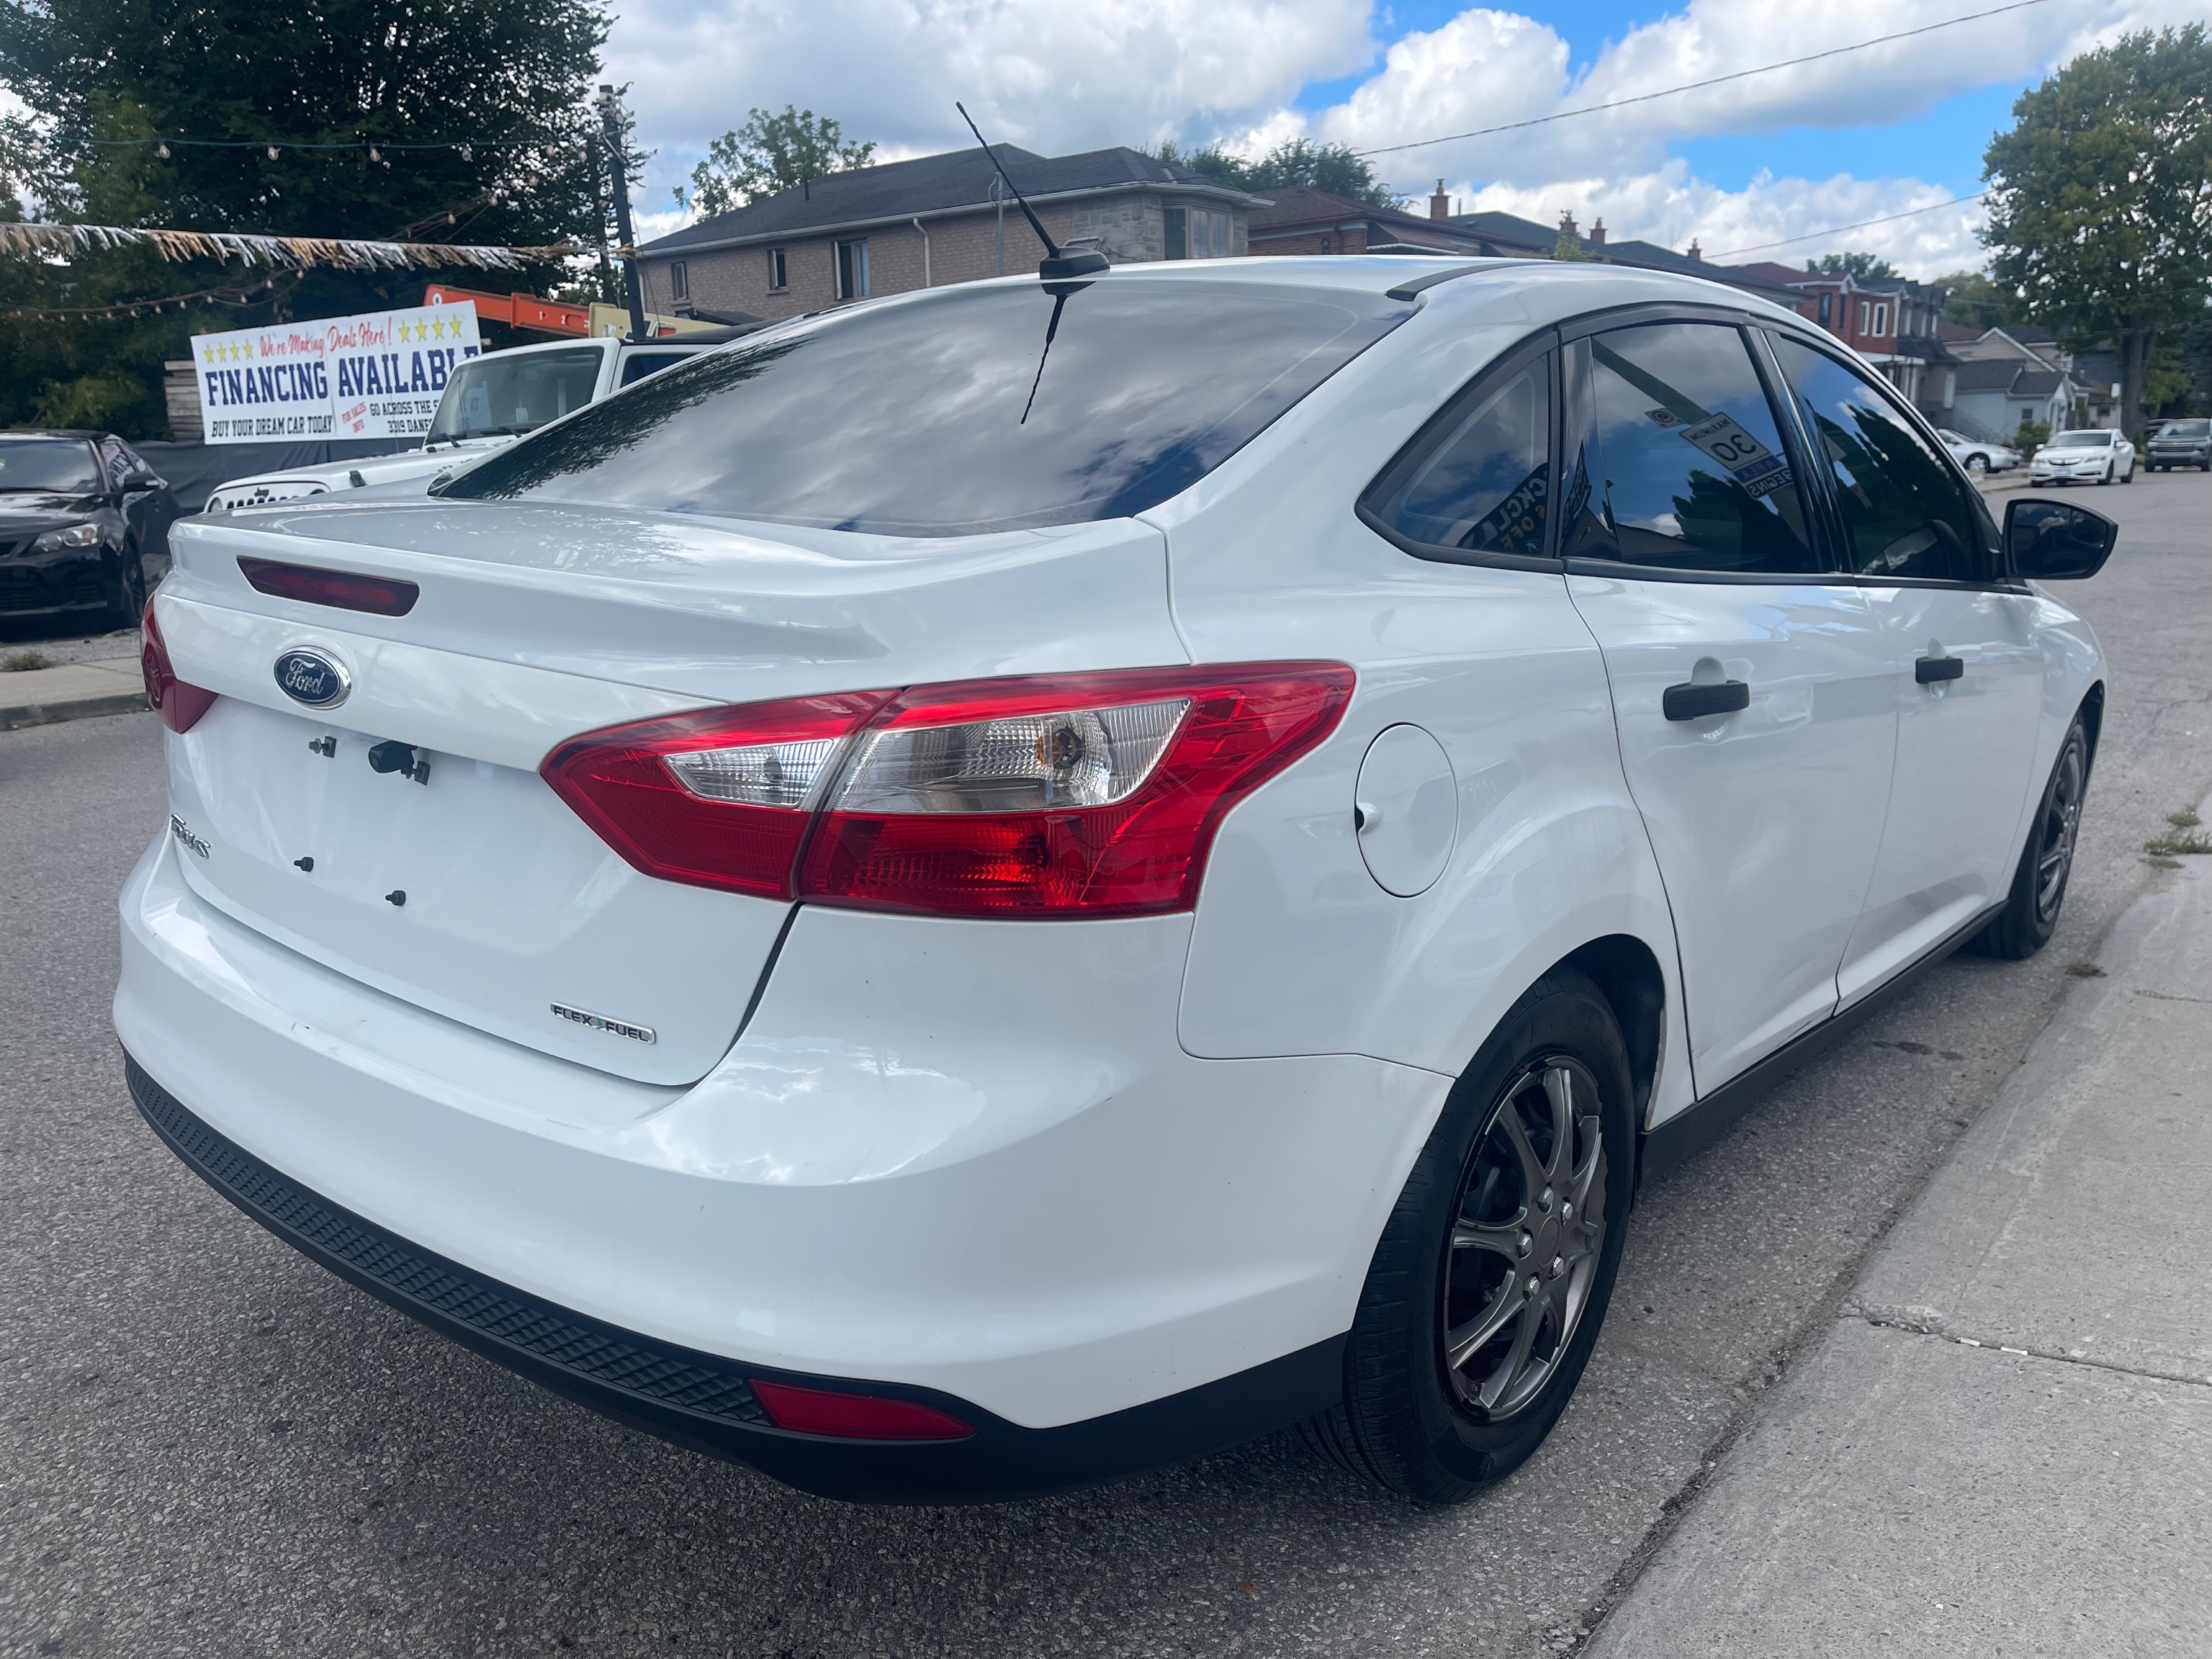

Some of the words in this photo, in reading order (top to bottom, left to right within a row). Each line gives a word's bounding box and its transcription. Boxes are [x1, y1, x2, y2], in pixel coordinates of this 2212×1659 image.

[259, 331, 286, 358] We're
[288, 332, 325, 359] Making
[328, 325, 357, 352] Deals
[358, 315, 392, 348] Here!
[205, 361, 328, 406] FINANCING
[341, 410, 351, 424] FOR
[351, 401, 367, 418] SALES
[369, 402, 380, 416] GO
[382, 401, 413, 415] ACROSS
[414, 400, 432, 413] THE
[212, 420, 230, 438] BUY
[232, 418, 253, 436] YOUR
[256, 417, 285, 436] DREAM
[287, 415, 305, 434] CAR
[307, 415, 333, 433] TODAY
[387, 420, 405, 433] 3319
[407, 418, 433, 433] DANF
[285, 657, 325, 695] Ford
[554, 1005, 593, 1027] FLEX
[606, 1021, 649, 1043] FUEL
